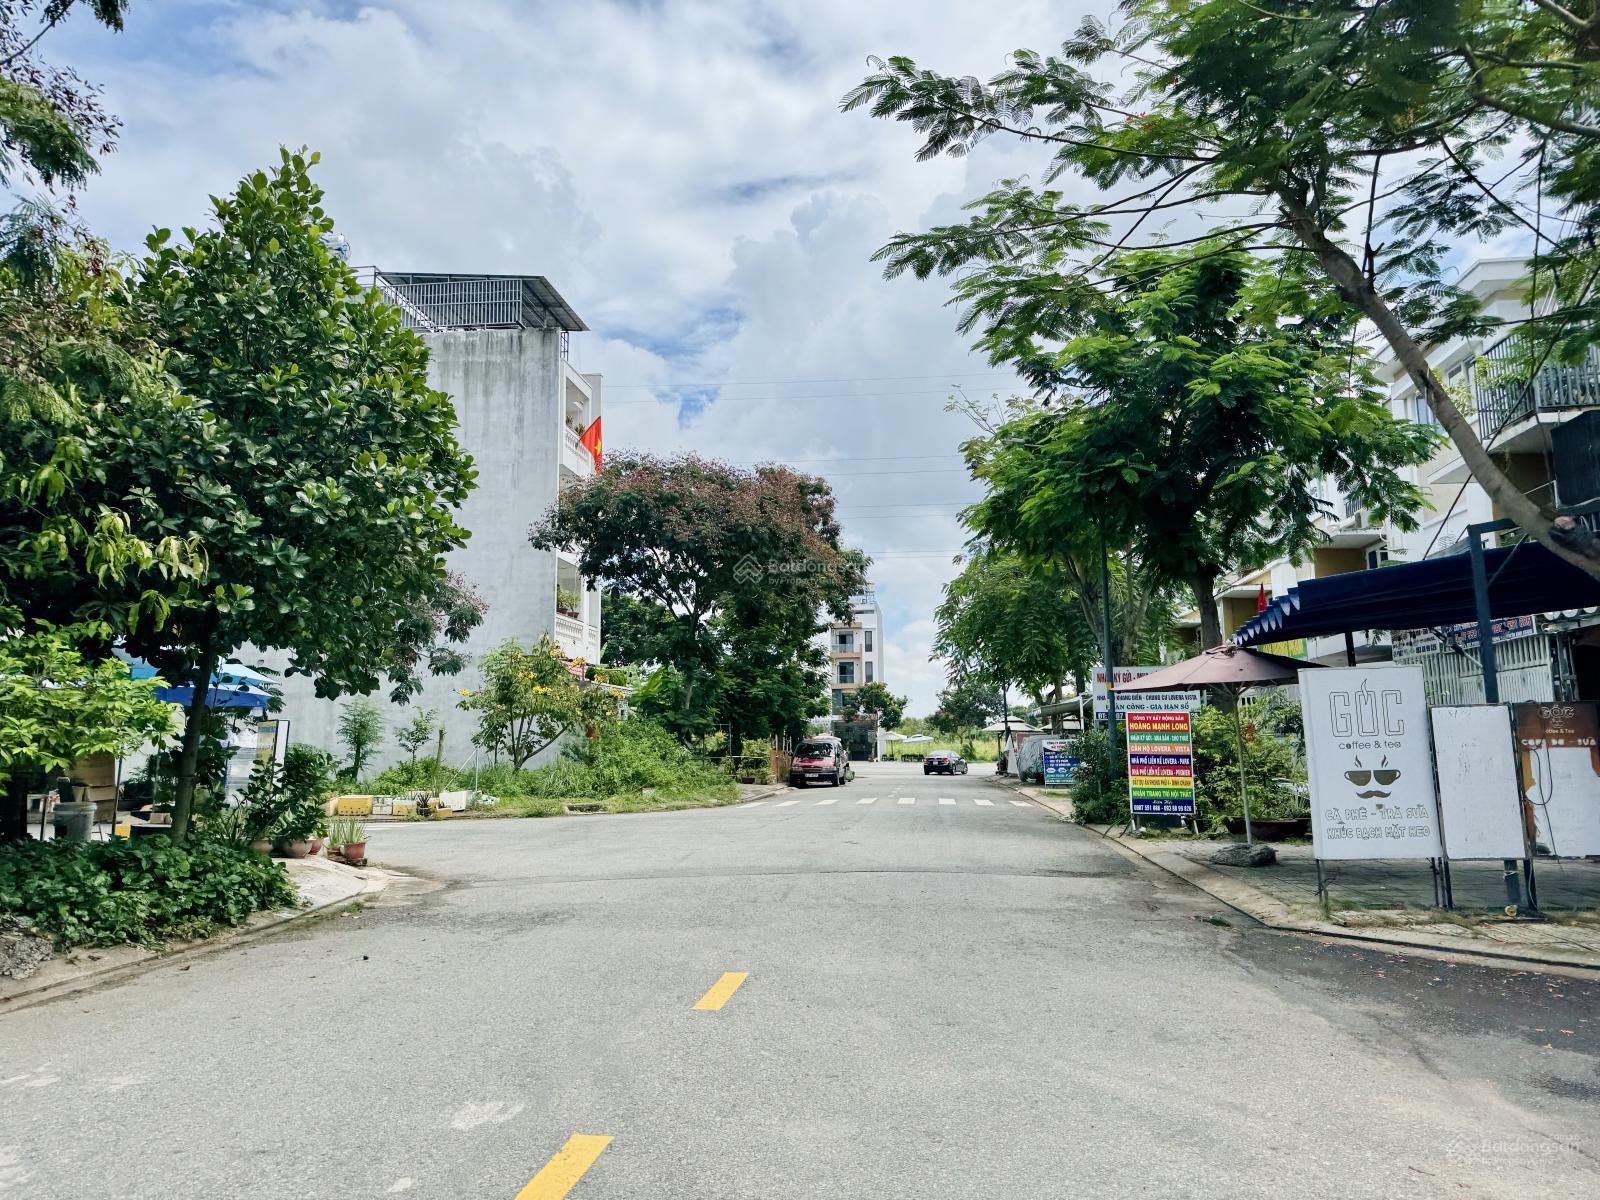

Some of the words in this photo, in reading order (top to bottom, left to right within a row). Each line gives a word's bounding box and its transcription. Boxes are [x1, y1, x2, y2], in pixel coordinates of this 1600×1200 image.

[1130, 721, 1151, 730] HOÀNG
[1152, 722, 1170, 732] MẠNH
[1171, 723, 1188, 731] LONG
[1338, 741, 1371, 750] coffee
[1374, 741, 1382, 750] &
[1384, 741, 1401, 750] tea
[1345, 806, 1367, 820] PHÊ
[1381, 805, 1402, 820] TRÀ
[1409, 825, 1430, 838] HEO
